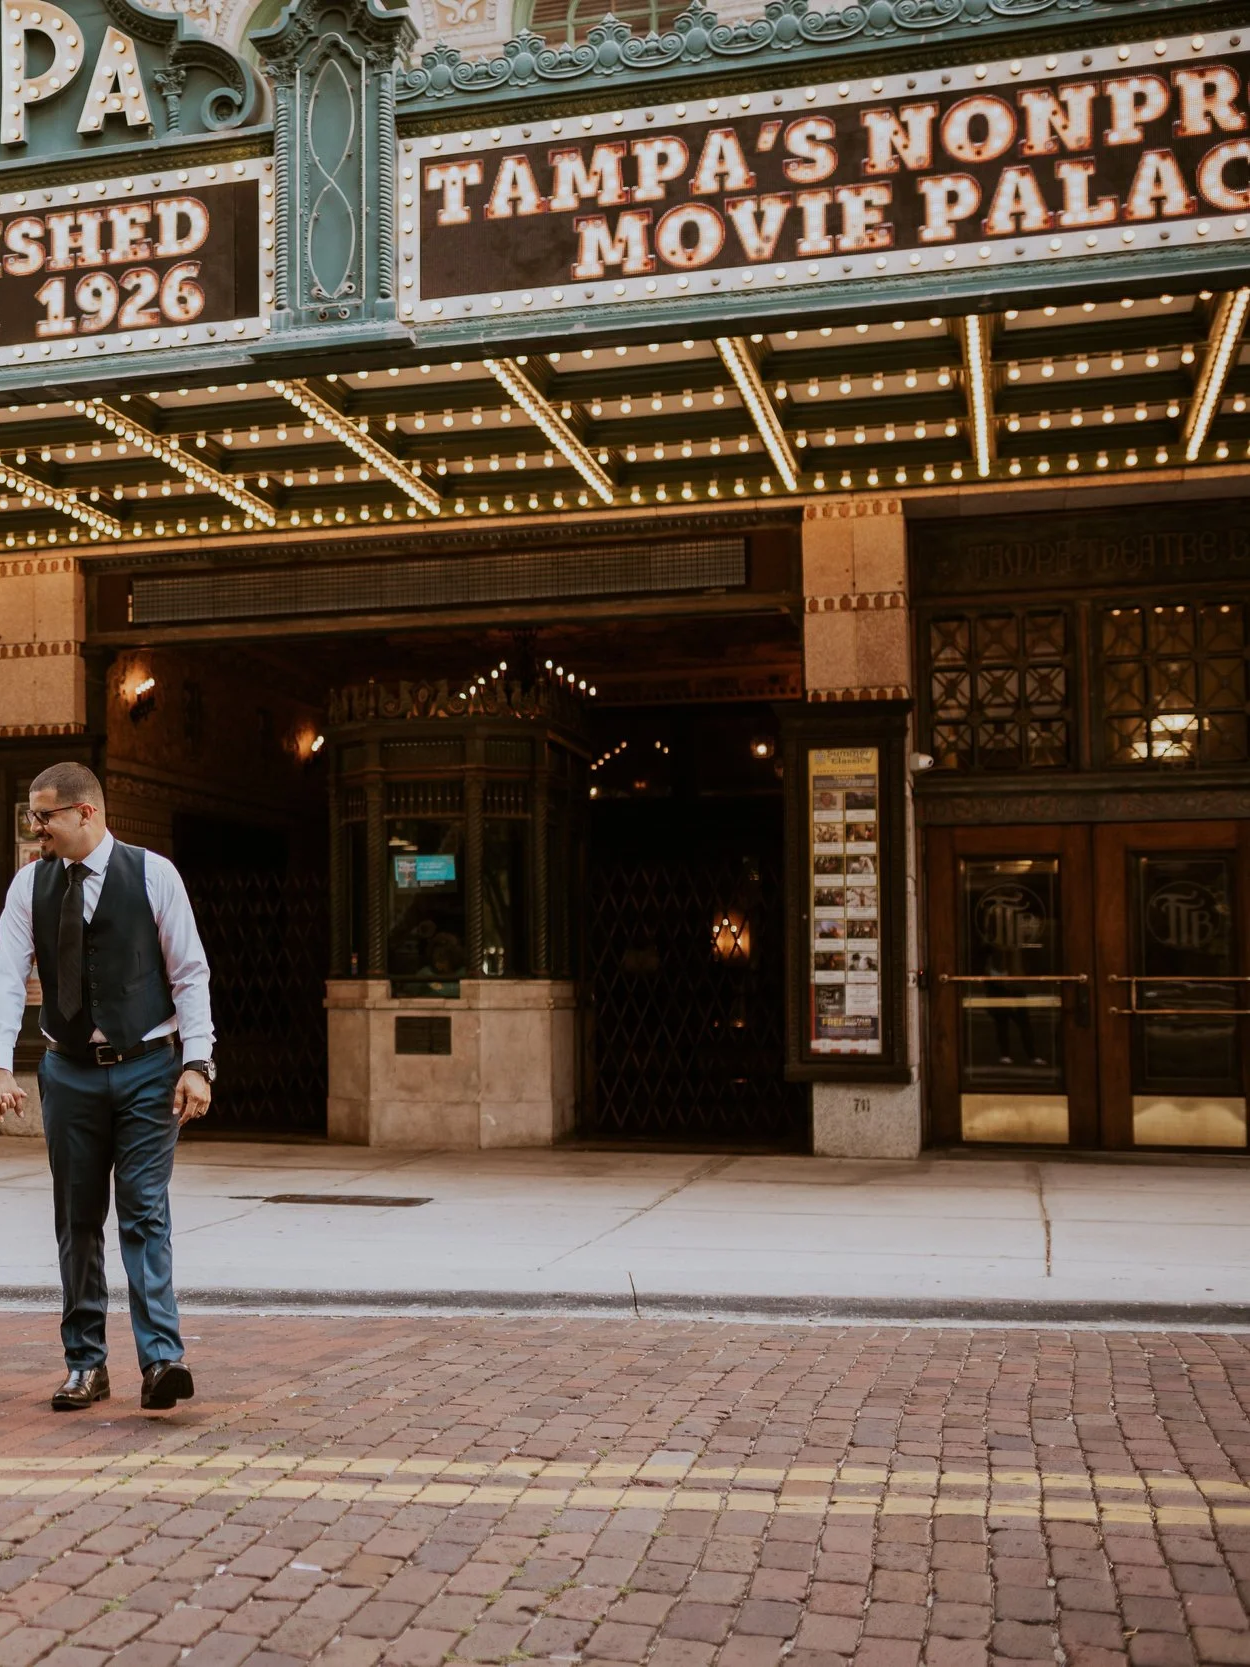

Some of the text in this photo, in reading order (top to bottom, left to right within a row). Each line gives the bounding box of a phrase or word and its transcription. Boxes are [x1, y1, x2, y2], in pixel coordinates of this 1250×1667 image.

[424, 63, 1250, 227] TAMPA'S NONPR
[570, 180, 894, 281] MOVIE
[34, 260, 206, 338] 1926
[853, 1098, 871, 1113] 711
